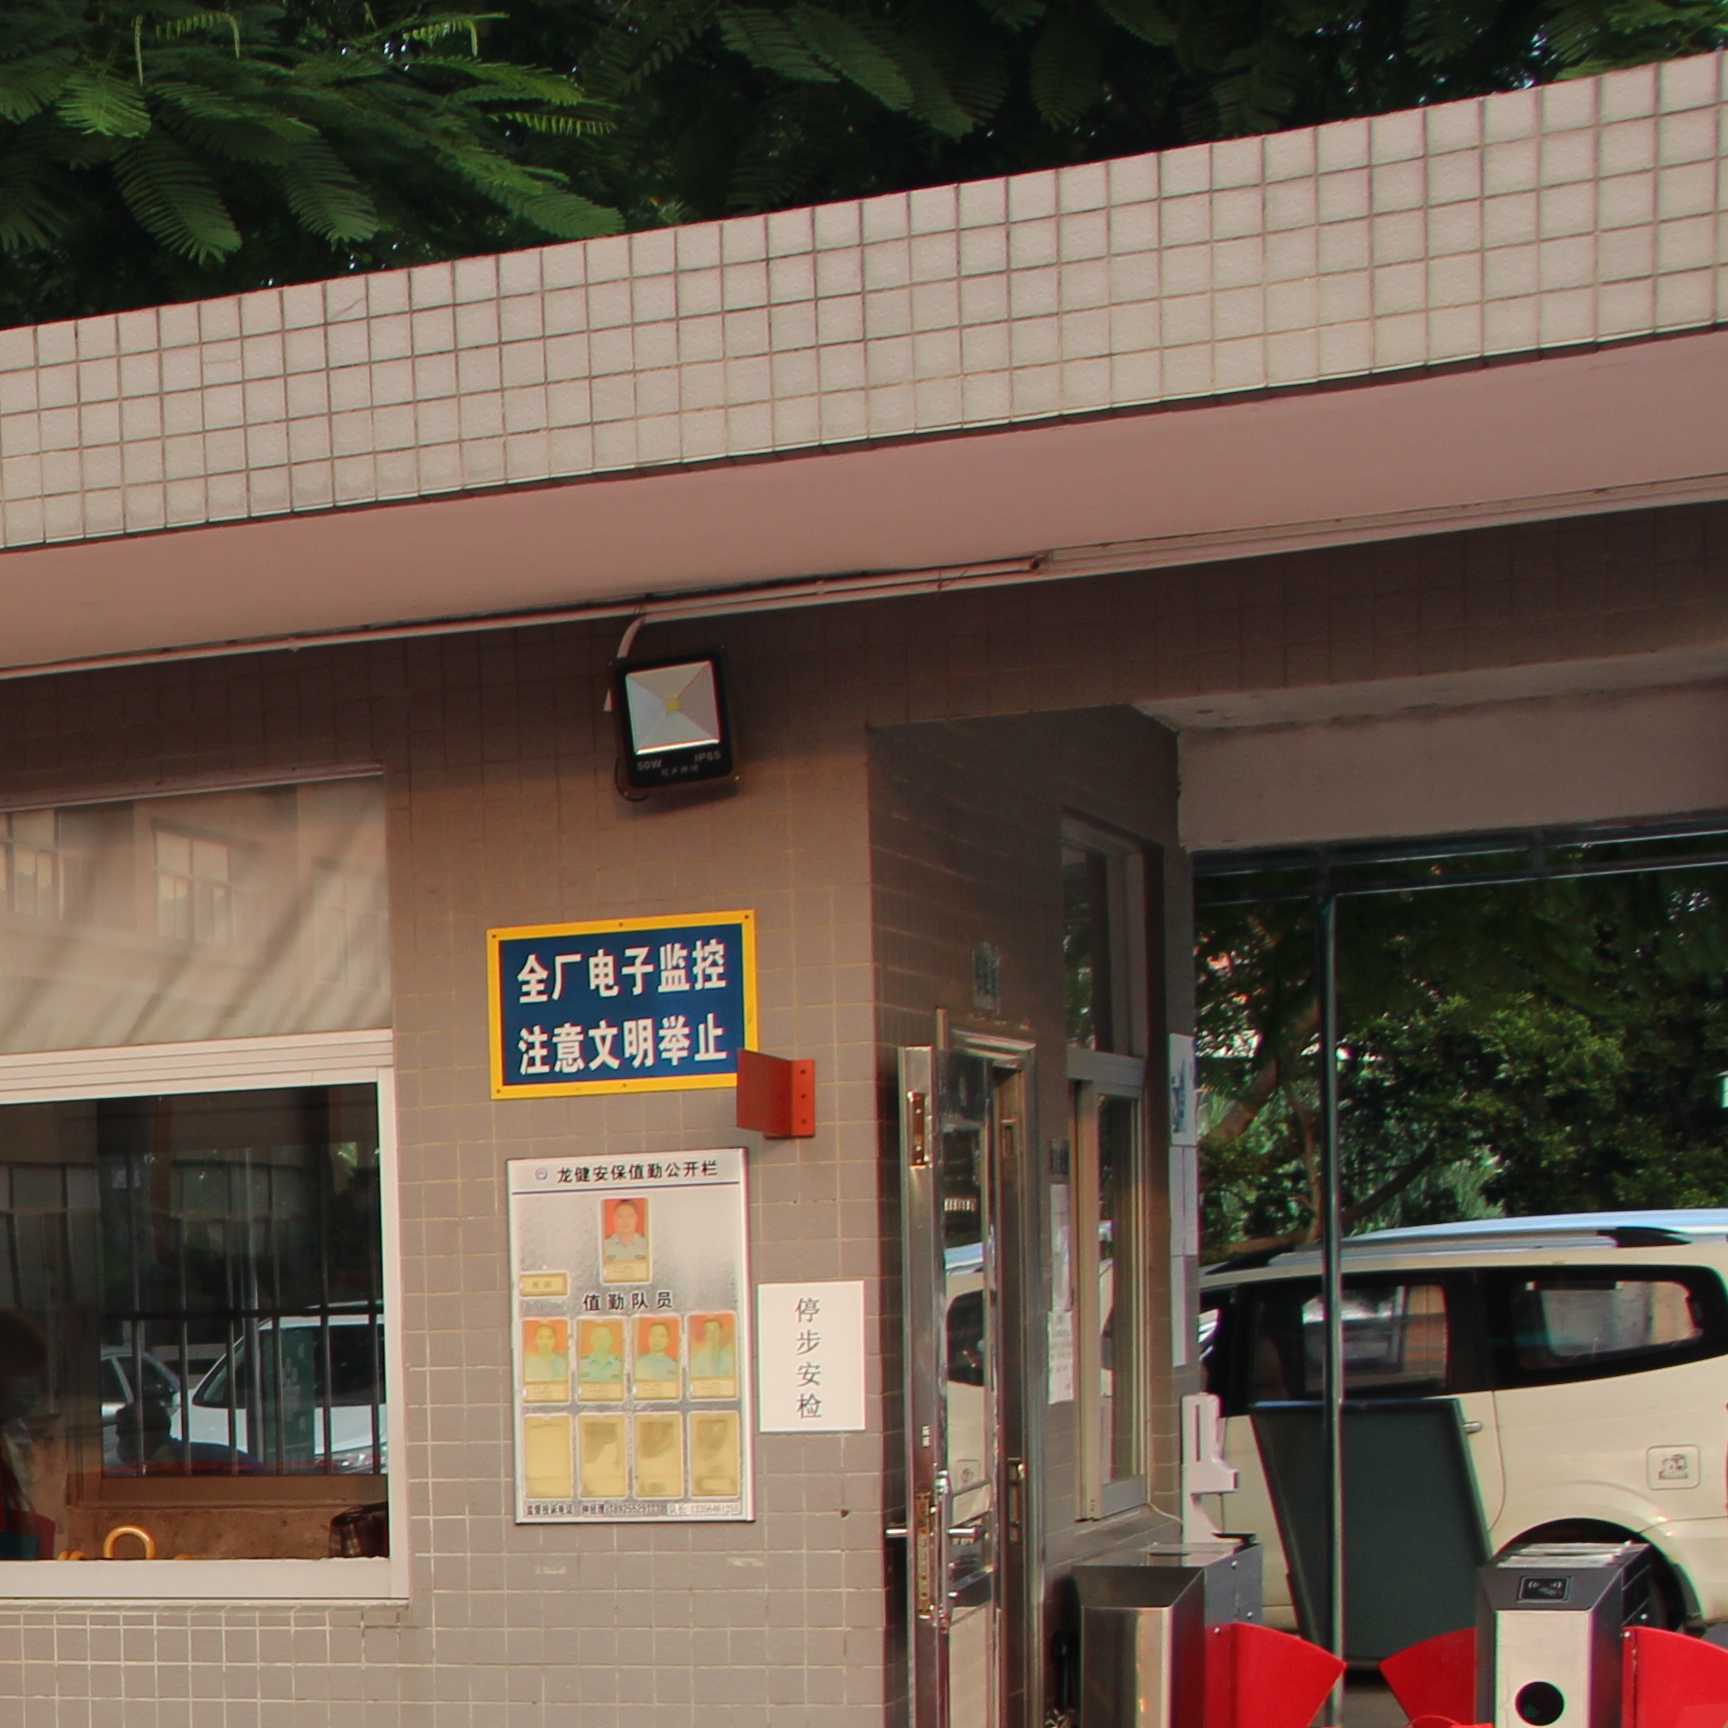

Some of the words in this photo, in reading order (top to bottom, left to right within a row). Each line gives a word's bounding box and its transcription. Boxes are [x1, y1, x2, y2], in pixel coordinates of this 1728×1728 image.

[517, 939, 728, 1004] 全厂电子监控
[518, 1014, 727, 1076] 注意文明举止
[557, 1160, 717, 1183] 龙健安保值勤公开栏
[583, 1292, 673, 1311] 值勤队员
[795, 1297, 822, 1420] 停步安检
